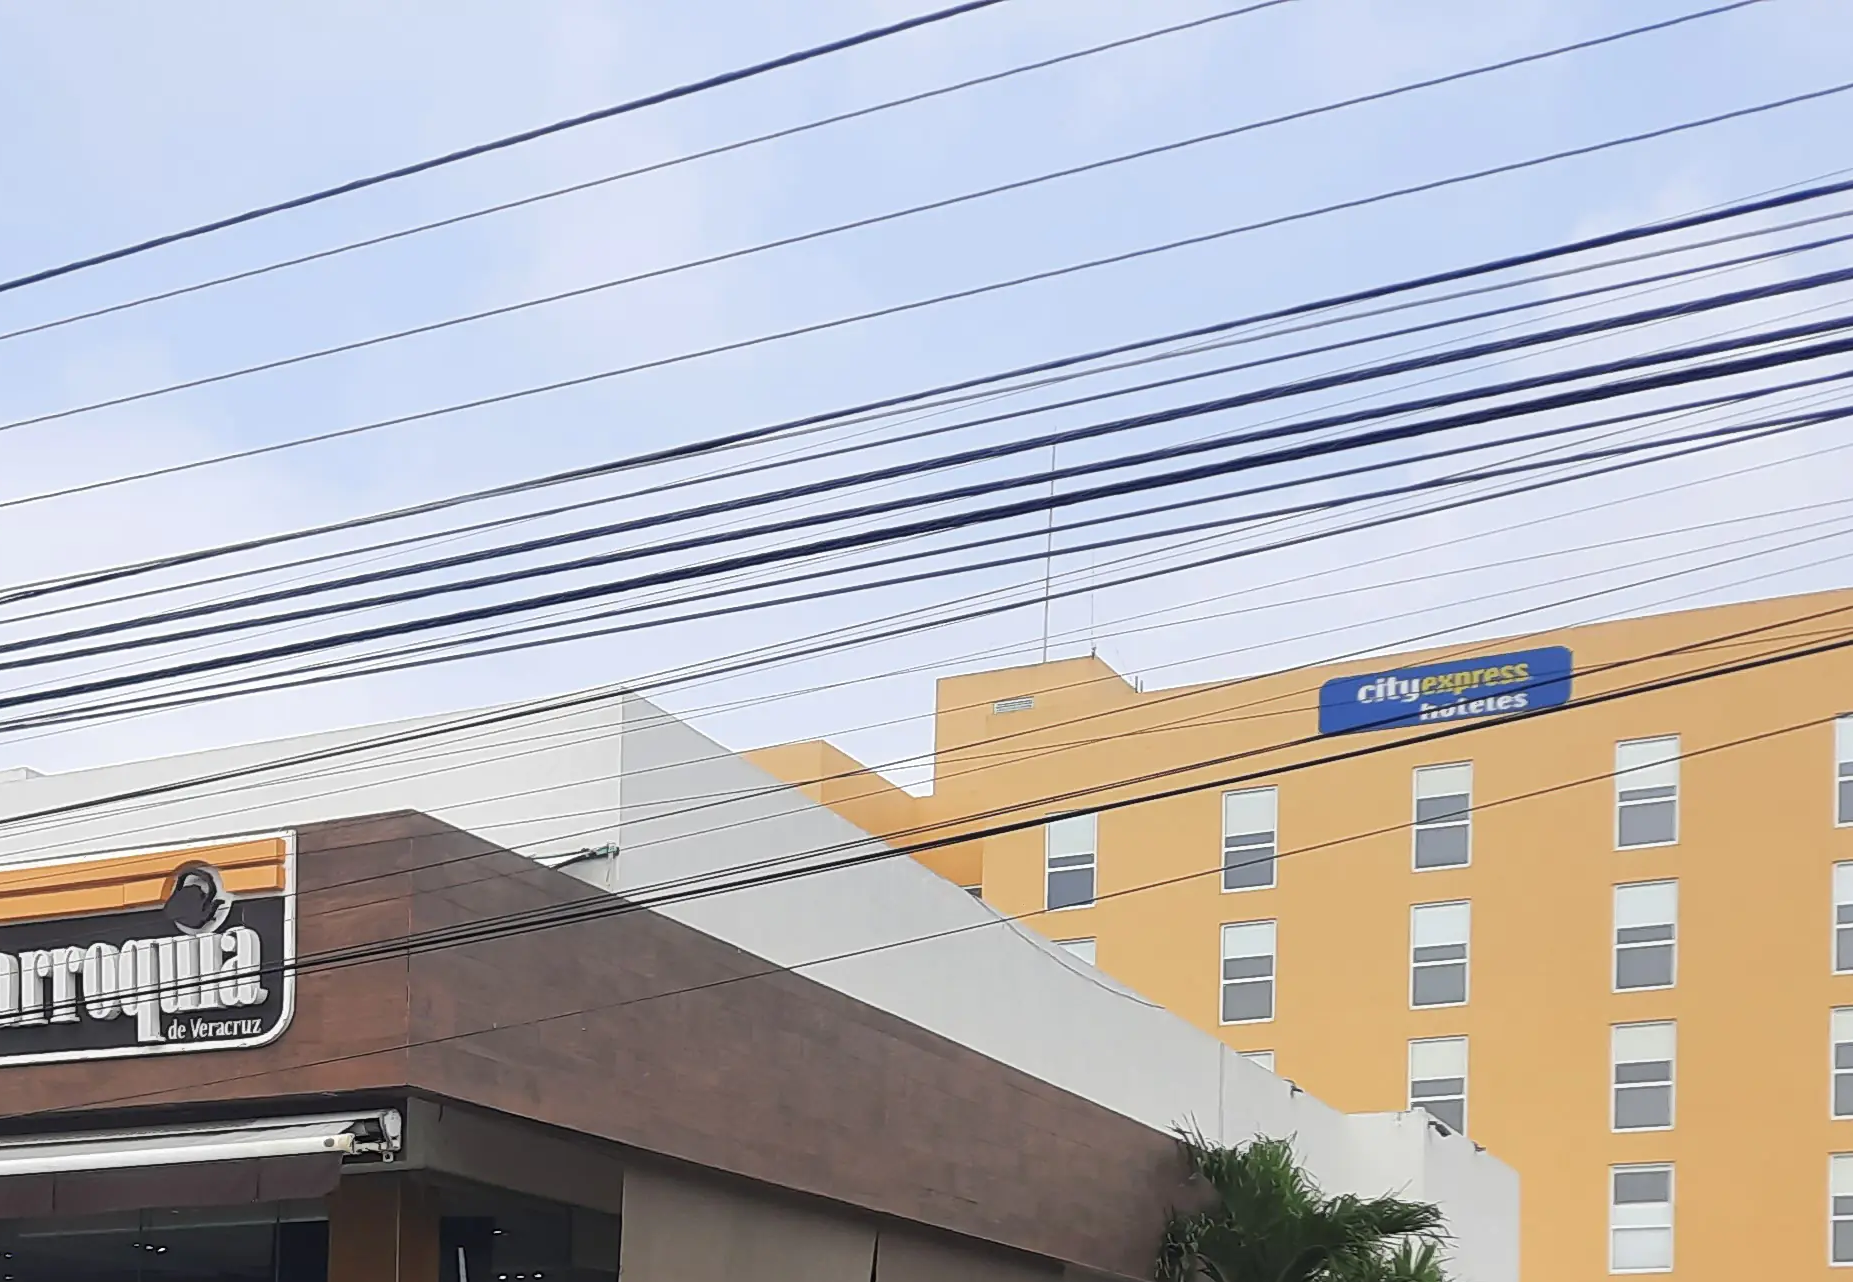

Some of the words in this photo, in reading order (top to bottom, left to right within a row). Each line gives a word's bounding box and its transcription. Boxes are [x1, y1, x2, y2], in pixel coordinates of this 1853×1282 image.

[1419, 692, 1529, 721] hoteles
[167, 1018, 186, 1039] de
[190, 1018, 262, 1038] Veracruz
